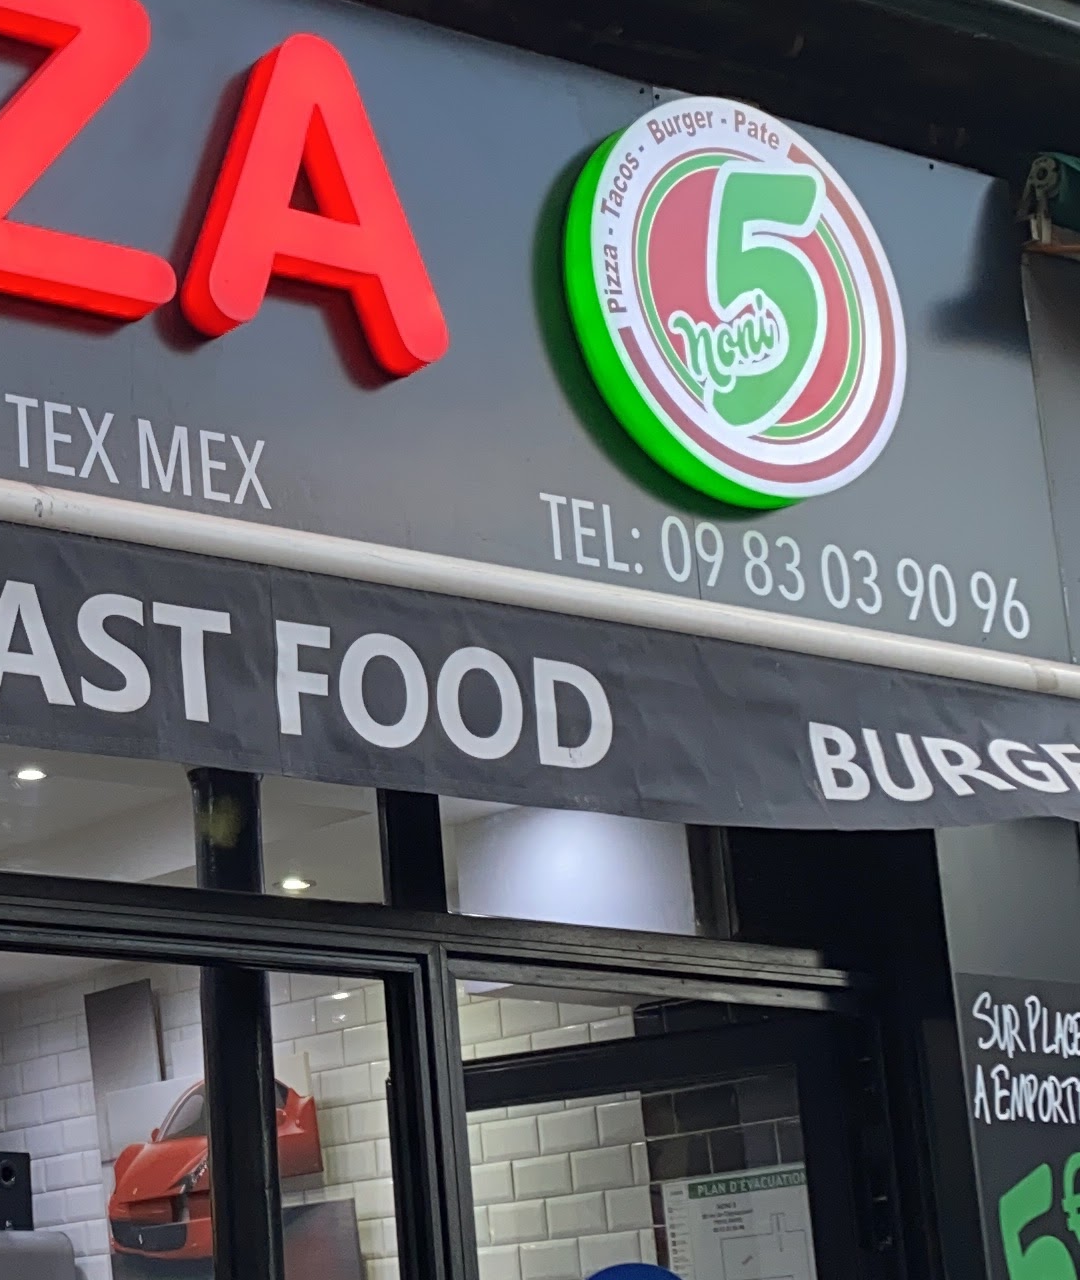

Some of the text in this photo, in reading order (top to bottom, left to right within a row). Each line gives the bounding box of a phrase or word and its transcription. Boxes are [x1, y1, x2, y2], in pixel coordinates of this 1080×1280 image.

[646, 109, 714, 145] Burger
[734, 109, 780, 150] Pate
[600, 151, 640, 220] Tacos
[603, 243, 627, 314] Pizza
[716, 171, 819, 426] 5
[4, 393, 120, 484] TEX
[137, 418, 272, 510] MEX
[540, 492, 1031, 639] TEL: 09 83 03 90 96
[274, 619, 614, 770] FOOD
[972, 991, 1027, 1059] SUR
[974, 1063, 1080, 1125] A EMPORT
[697, 1183, 727, 1197] PLAN
